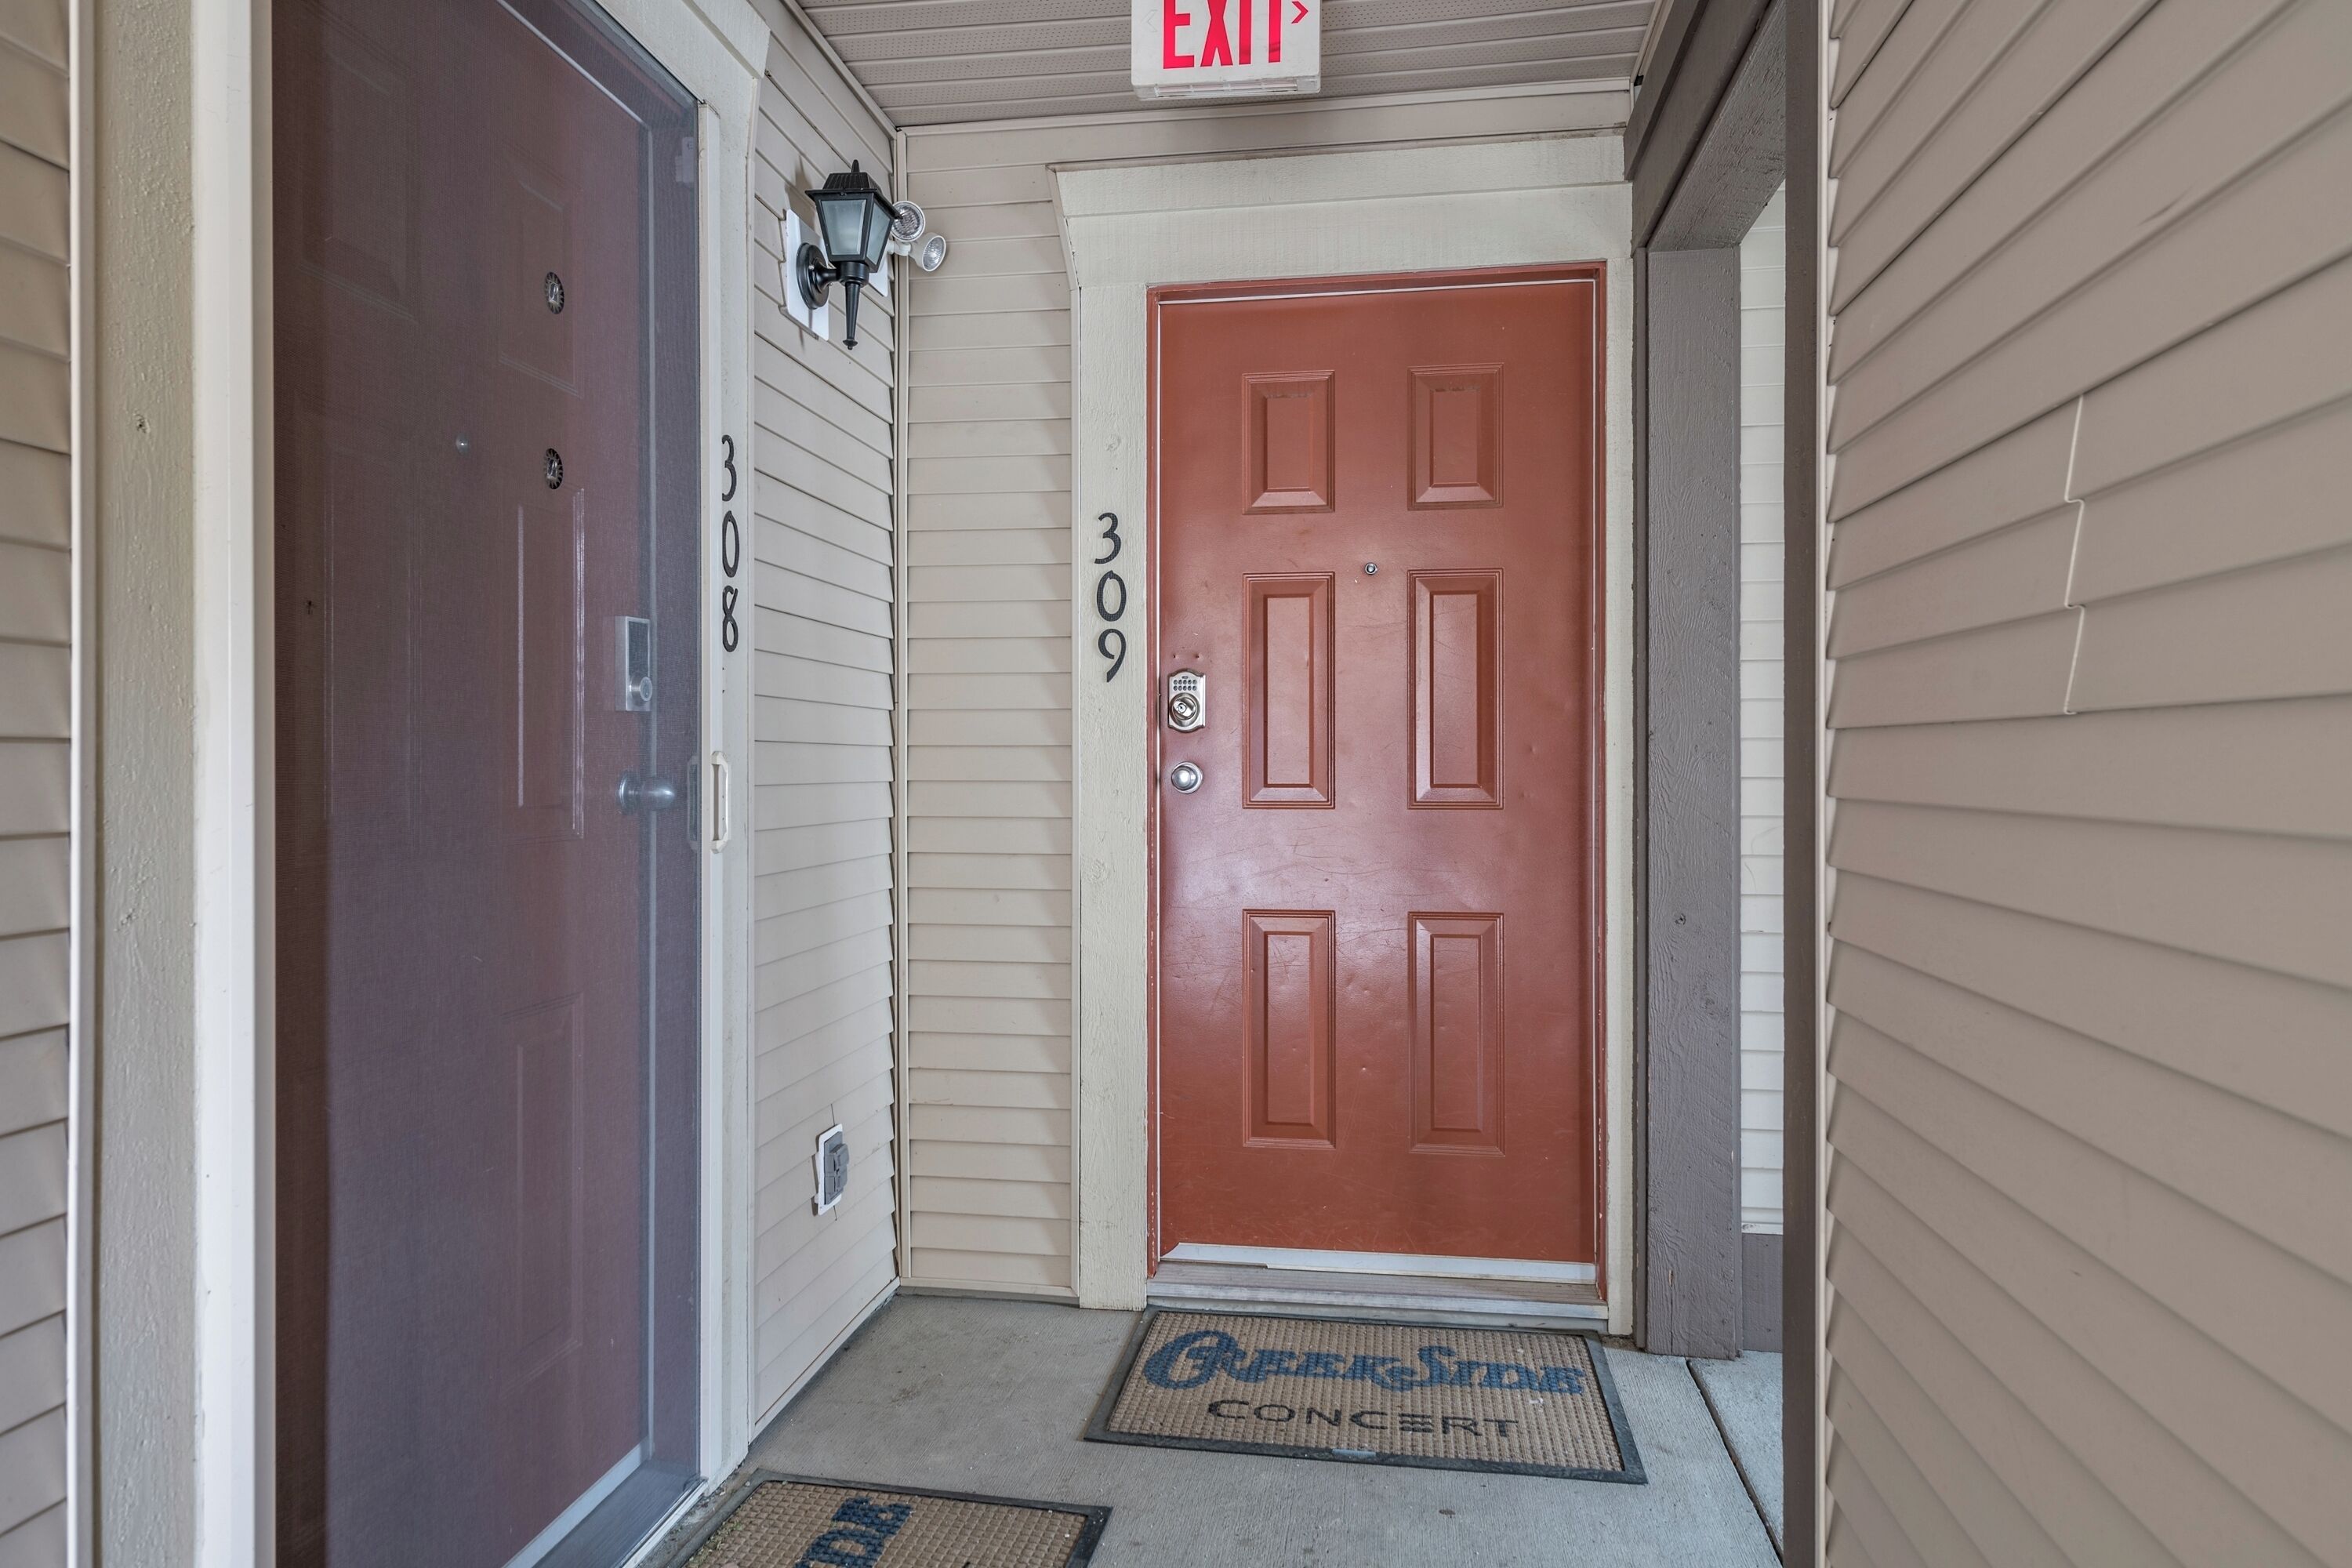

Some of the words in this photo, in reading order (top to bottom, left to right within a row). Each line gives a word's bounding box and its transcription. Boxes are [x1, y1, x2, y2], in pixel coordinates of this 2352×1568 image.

[721, 434, 740, 653] 308
[1094, 511, 1127, 683] 309
[1207, 1399, 1519, 1437] CONCERT
